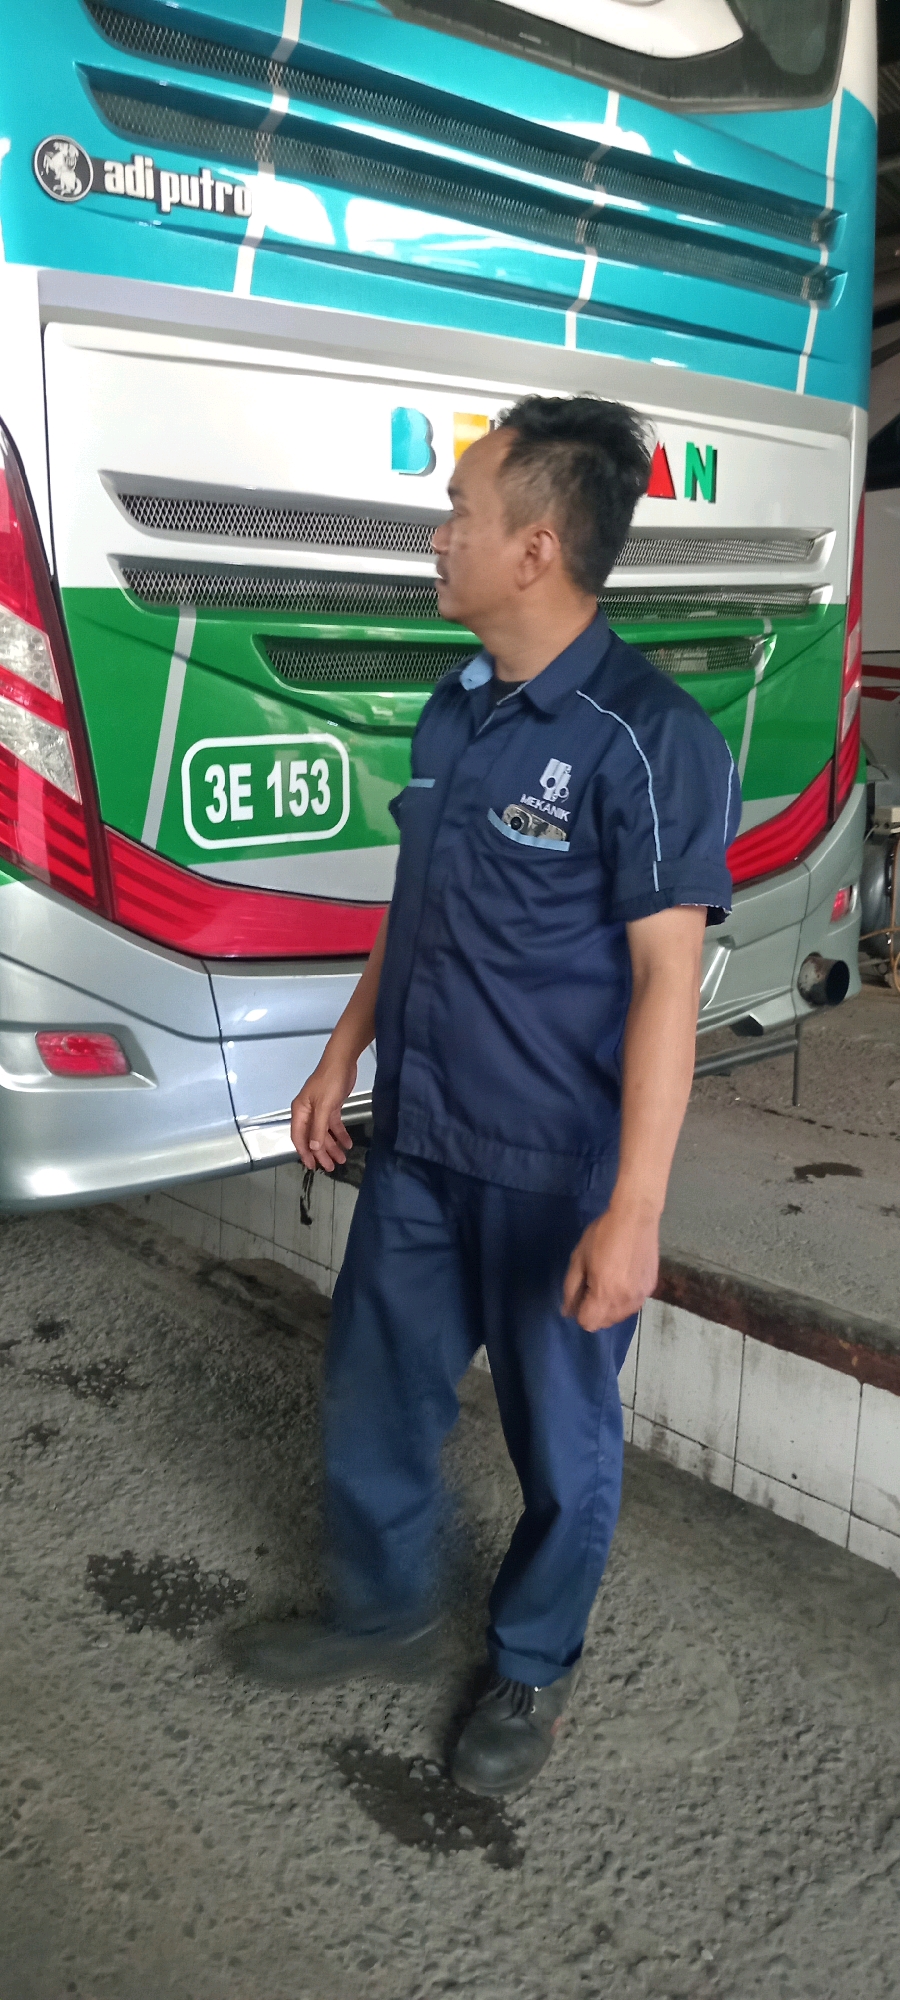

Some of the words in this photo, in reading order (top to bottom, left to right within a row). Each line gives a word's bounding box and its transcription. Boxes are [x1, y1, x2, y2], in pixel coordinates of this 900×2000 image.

[104, 154, 154, 200] adi
[160, 167, 252, 217] putro
[204, 763, 254, 824] 3E
[266, 758, 331, 818] 153
[520, 793, 571, 822] MEKANIK
